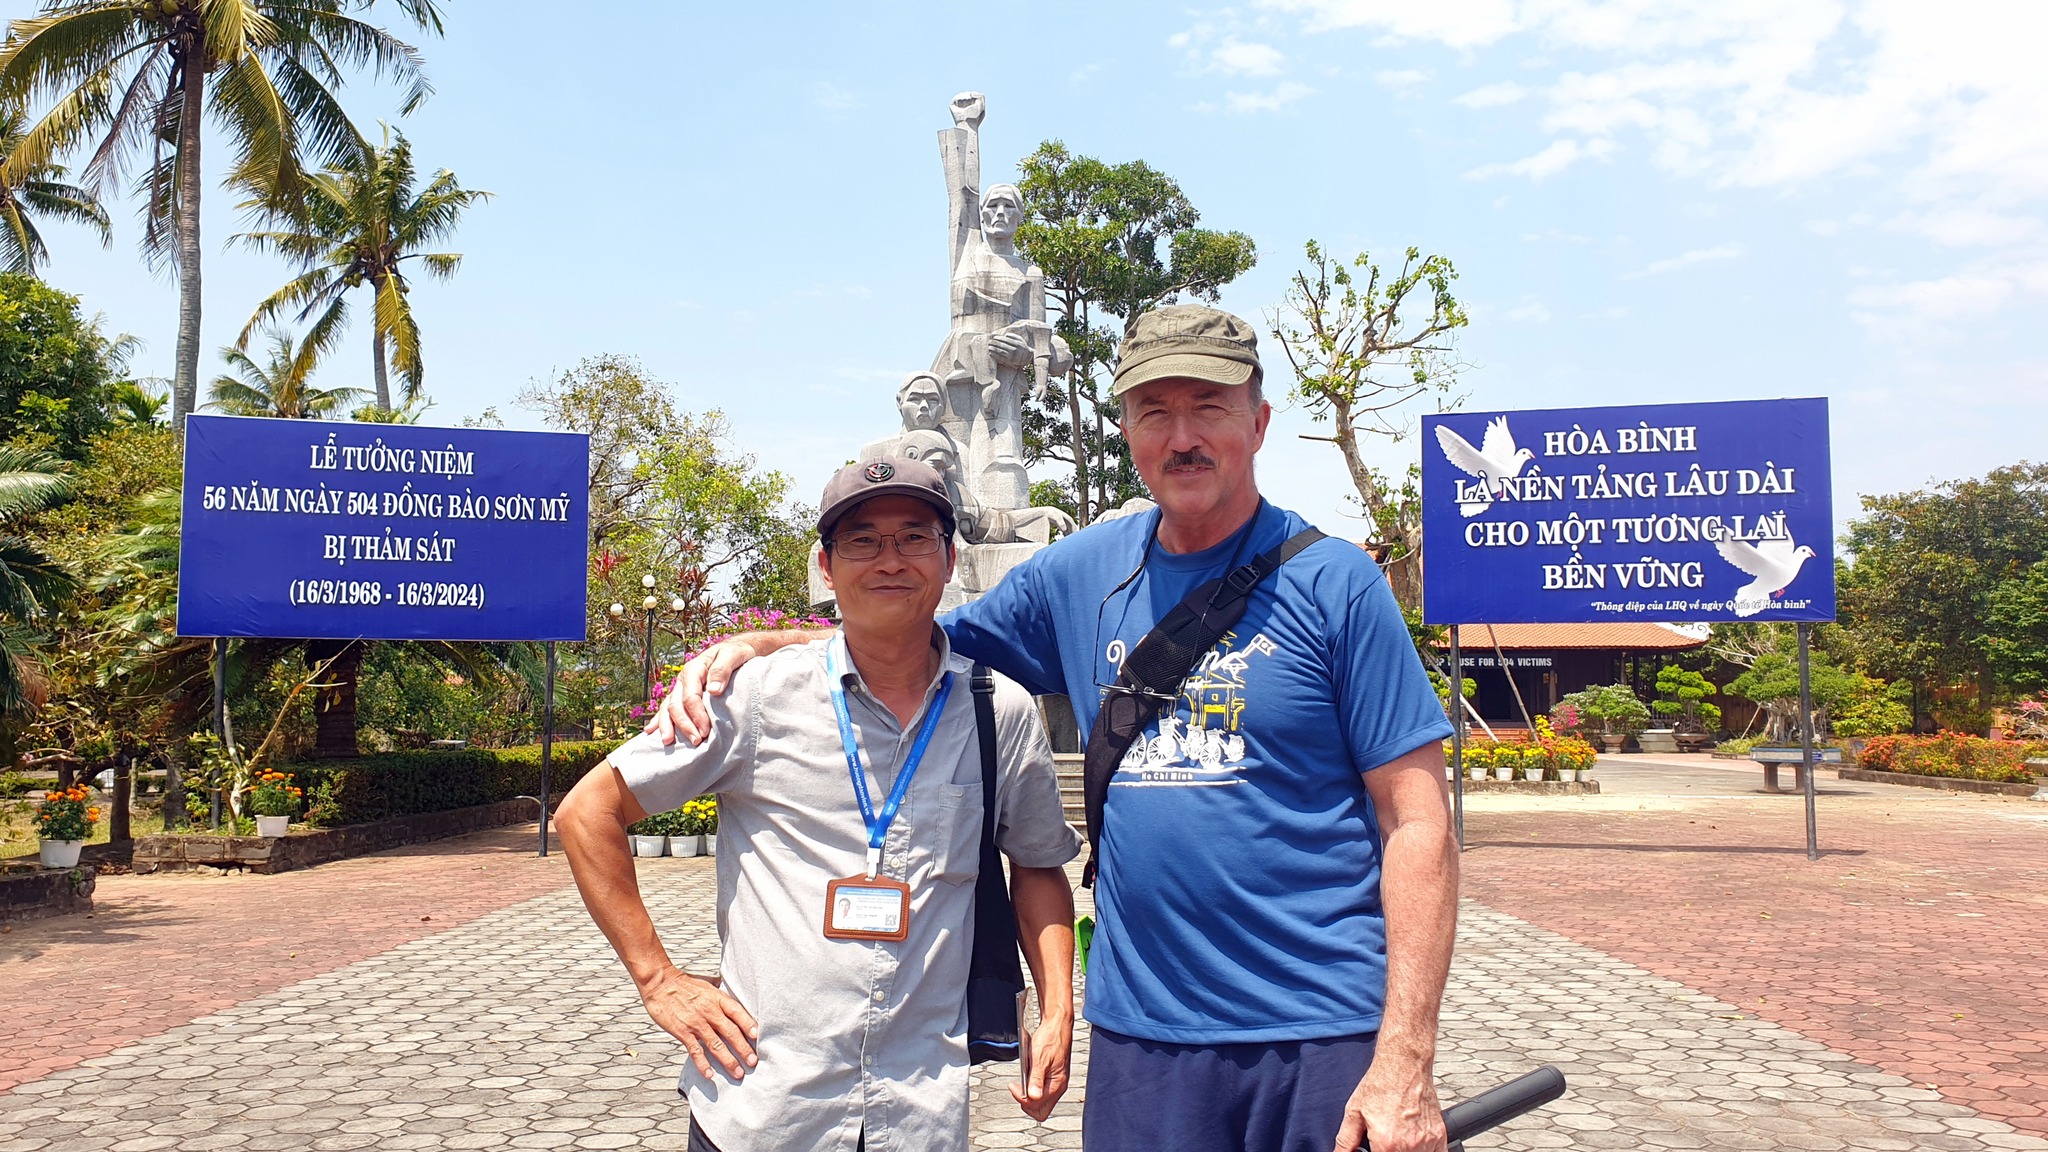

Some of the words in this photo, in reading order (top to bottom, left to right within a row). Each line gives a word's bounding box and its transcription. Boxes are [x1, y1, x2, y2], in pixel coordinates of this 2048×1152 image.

[310, 432, 337, 470] LỄ
[342, 438, 416, 473] TƯỞNG
[420, 444, 475, 480] NIỆM
[1543, 423, 1611, 456] HÒA
[1616, 420, 1697, 453] BÌNH
[1454, 470, 1494, 503] LÀ
[1499, 464, 1565, 501] NỀN
[1571, 464, 1658, 499] TẢNG
[1664, 463, 1729, 497] LÂU
[1736, 460, 1795, 495] DÀI
[203, 485, 226, 510] 56
[230, 480, 280, 512] NĂM
[284, 482, 344, 514] NGÀY
[347, 491, 378, 516] 504
[382, 481, 444, 518] ĐỒNG
[447, 488, 490, 519] BÀO
[494, 493, 536, 520] SƠN
[540, 492, 571, 522] MỸ
[323, 535, 347, 566] BỊ
[351, 526, 412, 561] THẢM
[416, 530, 456, 562] SÁT
[1464, 520, 1529, 547] CHO
[1536, 512, 1606, 552] MỘT
[1612, 513, 1725, 543] TƯƠNG
[1731, 514, 1787, 541] LAI
[1542, 552, 1607, 589] BỀN
[1612, 556, 1704, 588] VỮNG
[289, 579, 381, 608] (16/3/1968
[385, 592, 392, 600] -
[397, 581, 485, 610] 16/3/2024)
[1625, 601, 1646, 613] điệp
[1646, 600, 1663, 610] của
[1665, 600, 1687, 612] LHQ
[1701, 600, 1724, 611] ngày
[1478, 657, 1494, 667] FOR
[1497, 657, 1514, 667] 504
[1517, 657, 1552, 667] VICTIMS
